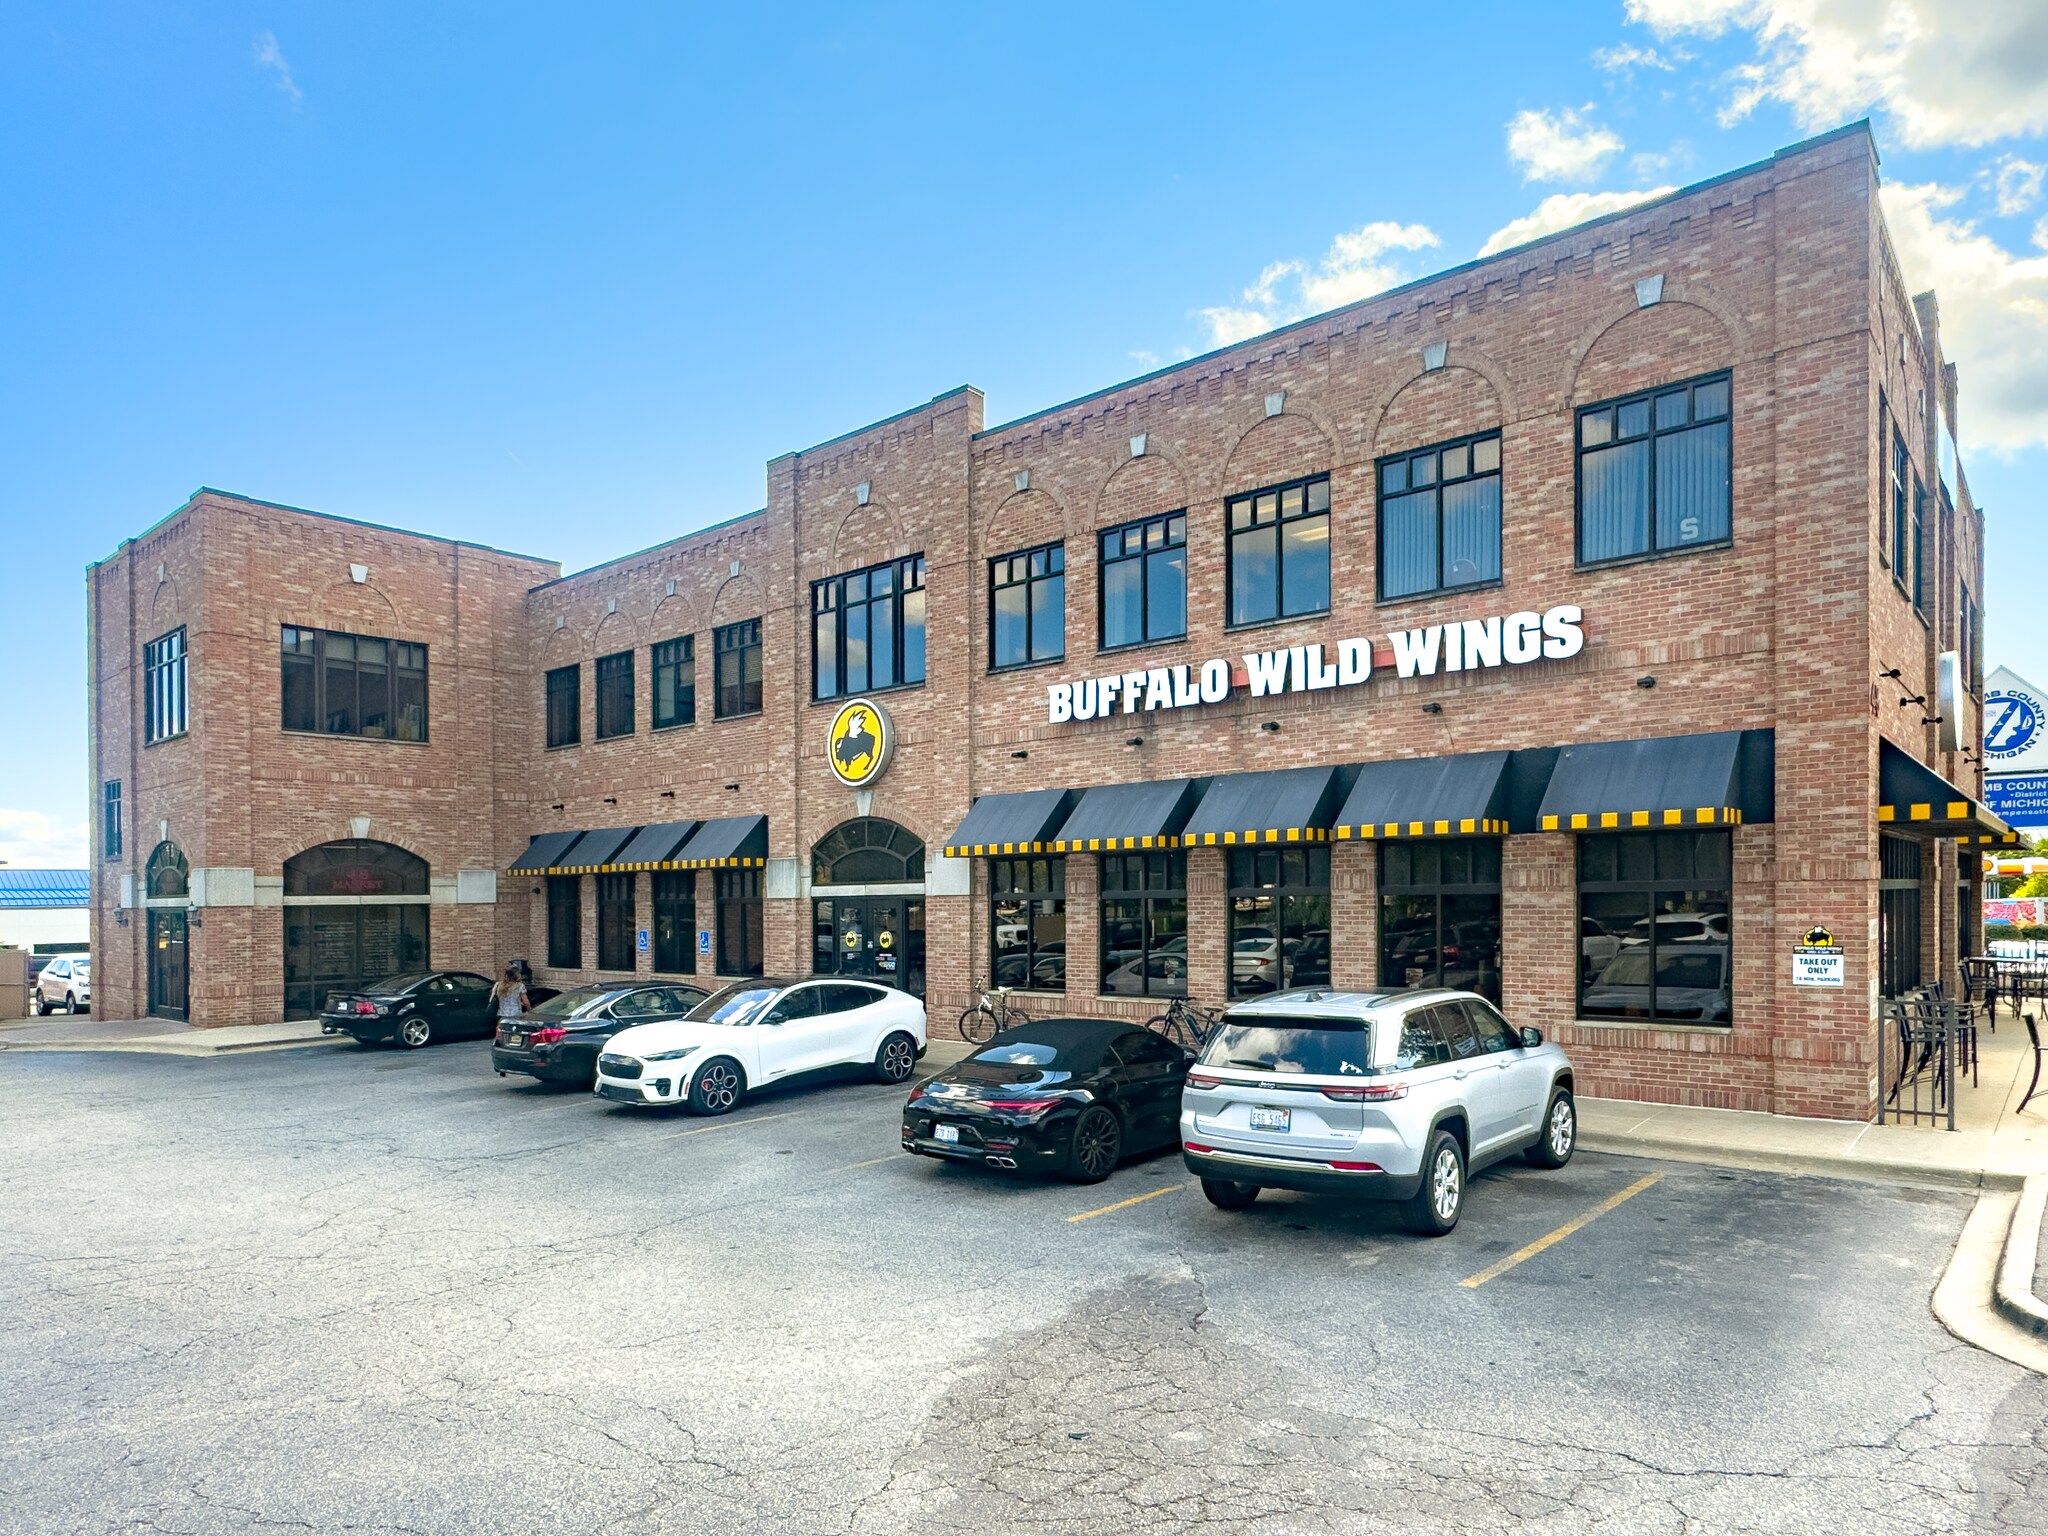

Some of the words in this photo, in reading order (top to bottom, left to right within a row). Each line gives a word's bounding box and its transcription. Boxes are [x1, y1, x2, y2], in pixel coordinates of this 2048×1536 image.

[1680, 516, 1699, 541] S
[1047, 658, 1230, 725] BUFFALO
[1243, 637, 1373, 697] WILD
[1387, 604, 1585, 679] WINGS
[2007, 690, 2046, 730] COUNTY
[1820, 958, 1837, 966] OUT
